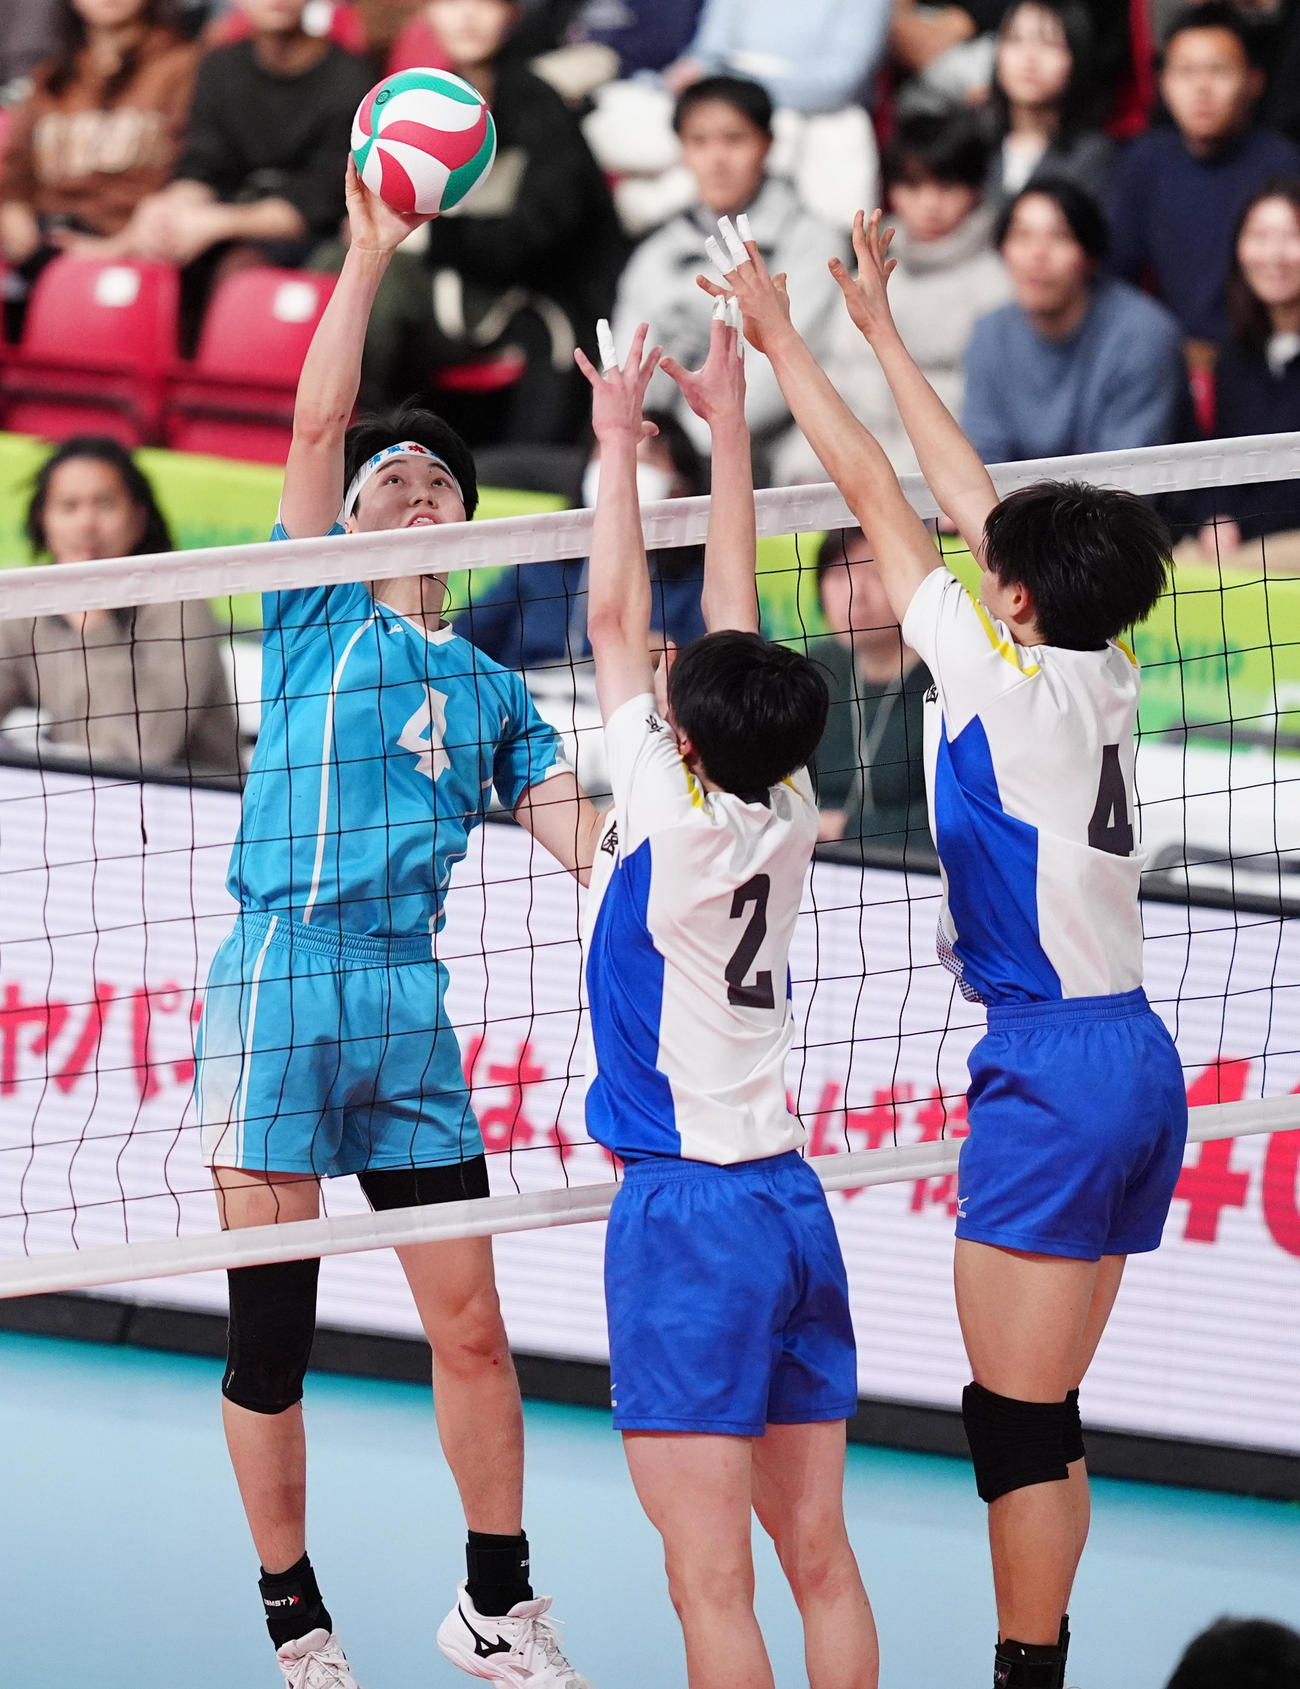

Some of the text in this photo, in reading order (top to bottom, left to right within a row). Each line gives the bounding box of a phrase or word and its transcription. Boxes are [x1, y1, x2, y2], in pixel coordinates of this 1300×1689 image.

[396, 682, 451, 783] 4
[1087, 743, 1134, 858] 4
[724, 873, 775, 1009] 2
